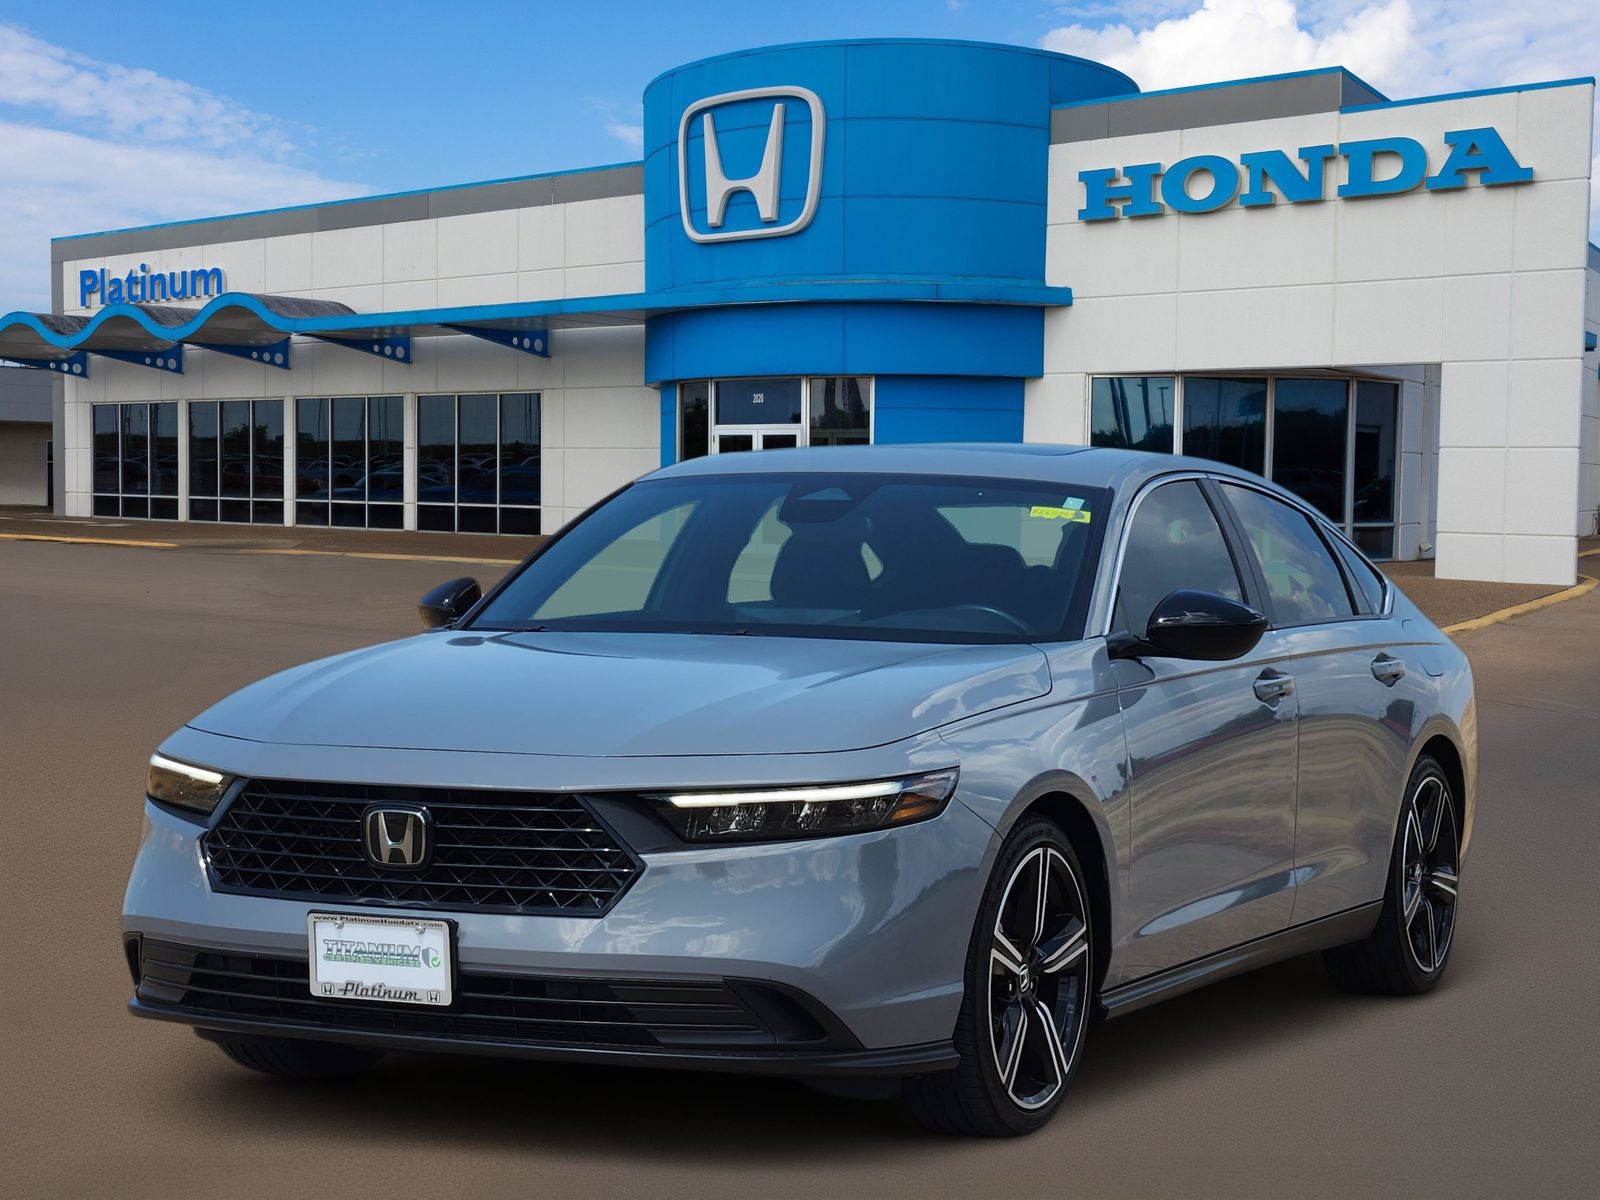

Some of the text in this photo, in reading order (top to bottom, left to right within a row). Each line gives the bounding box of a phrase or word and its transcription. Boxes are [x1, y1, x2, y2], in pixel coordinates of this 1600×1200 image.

[1078, 127, 1534, 222] HONDA
[79, 263, 226, 308] Platinum
[323, 939, 421, 960] TITANIUM
[323, 954, 422, 968] CERTIFIED VEHICLES
[337, 981, 424, 1002] Platinum
